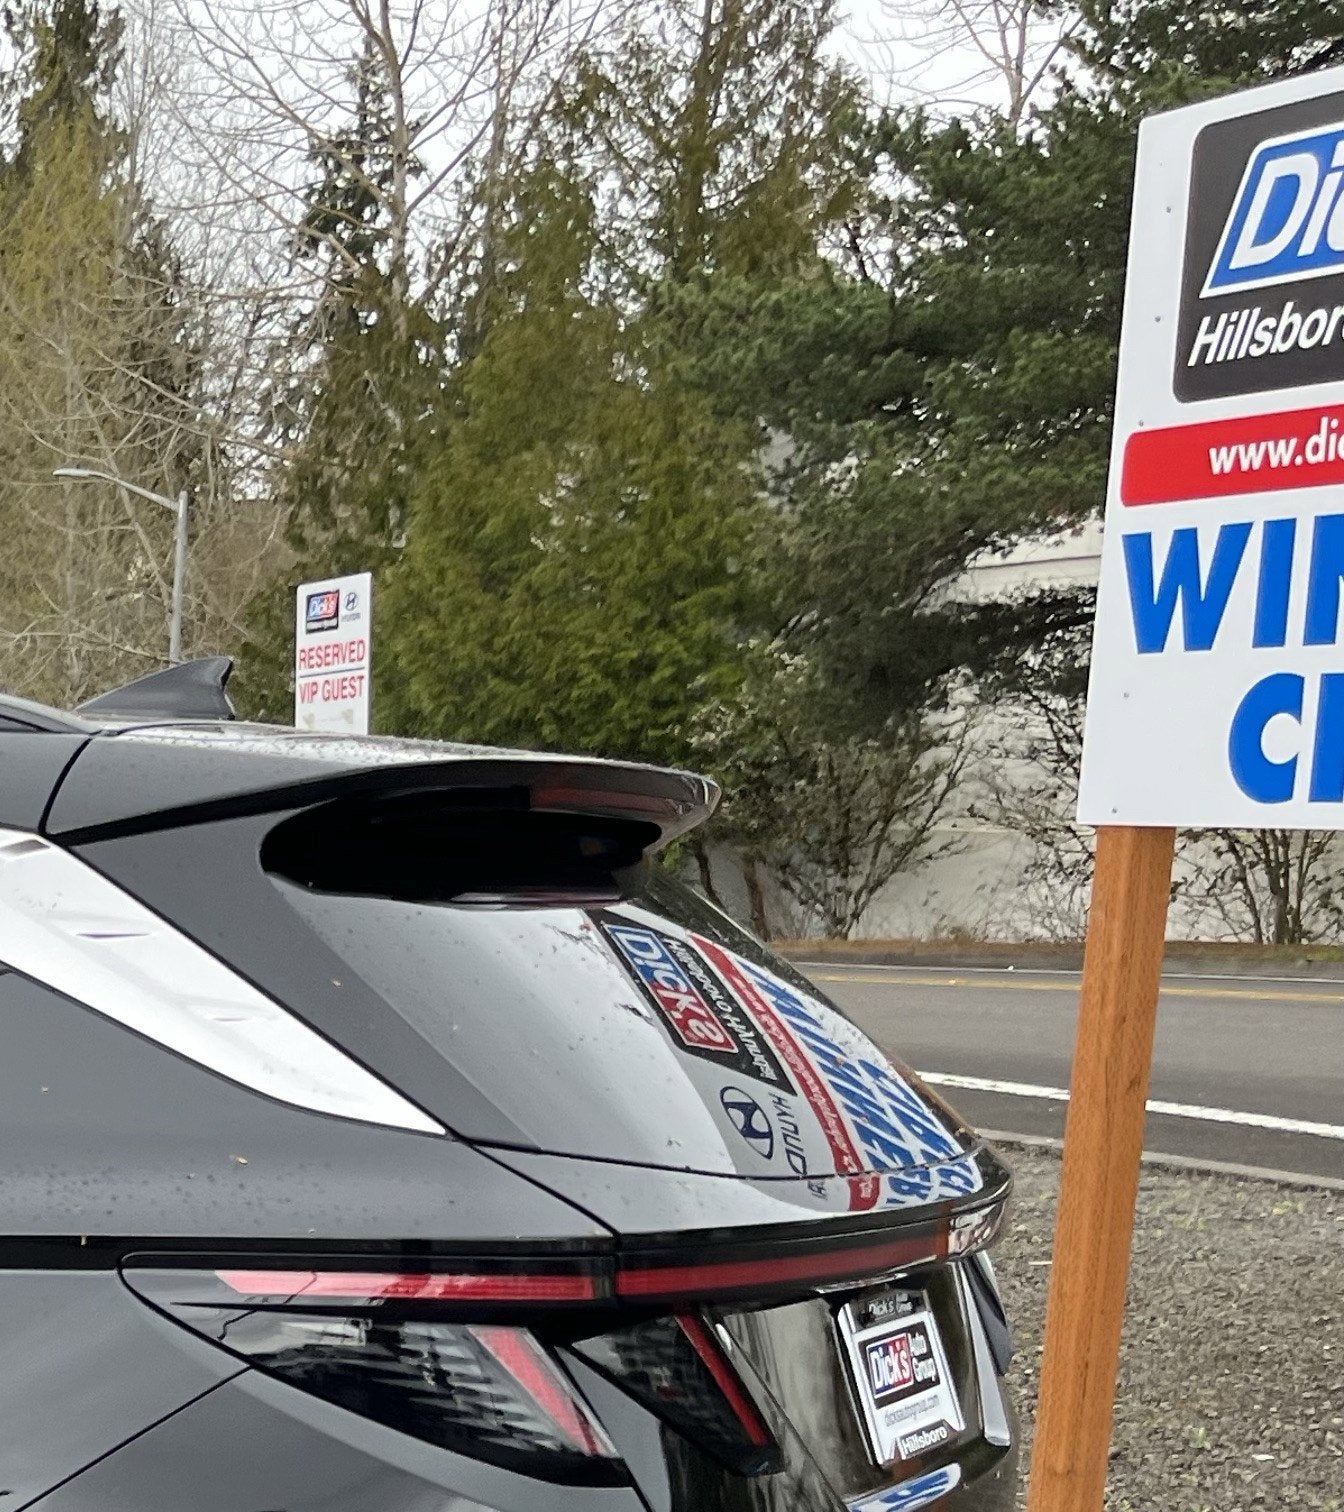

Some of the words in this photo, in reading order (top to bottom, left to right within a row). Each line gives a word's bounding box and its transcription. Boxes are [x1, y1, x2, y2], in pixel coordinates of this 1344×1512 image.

[1187, 301, 1344, 367] Hillsbor
[299, 640, 365, 670] RESERVED
[299, 681, 318, 704] VIP
[322, 675, 364, 702] GUEST
[870, 1342, 910, 1388] Dick's
[901, 1425, 948, 1455] Hillsboro
